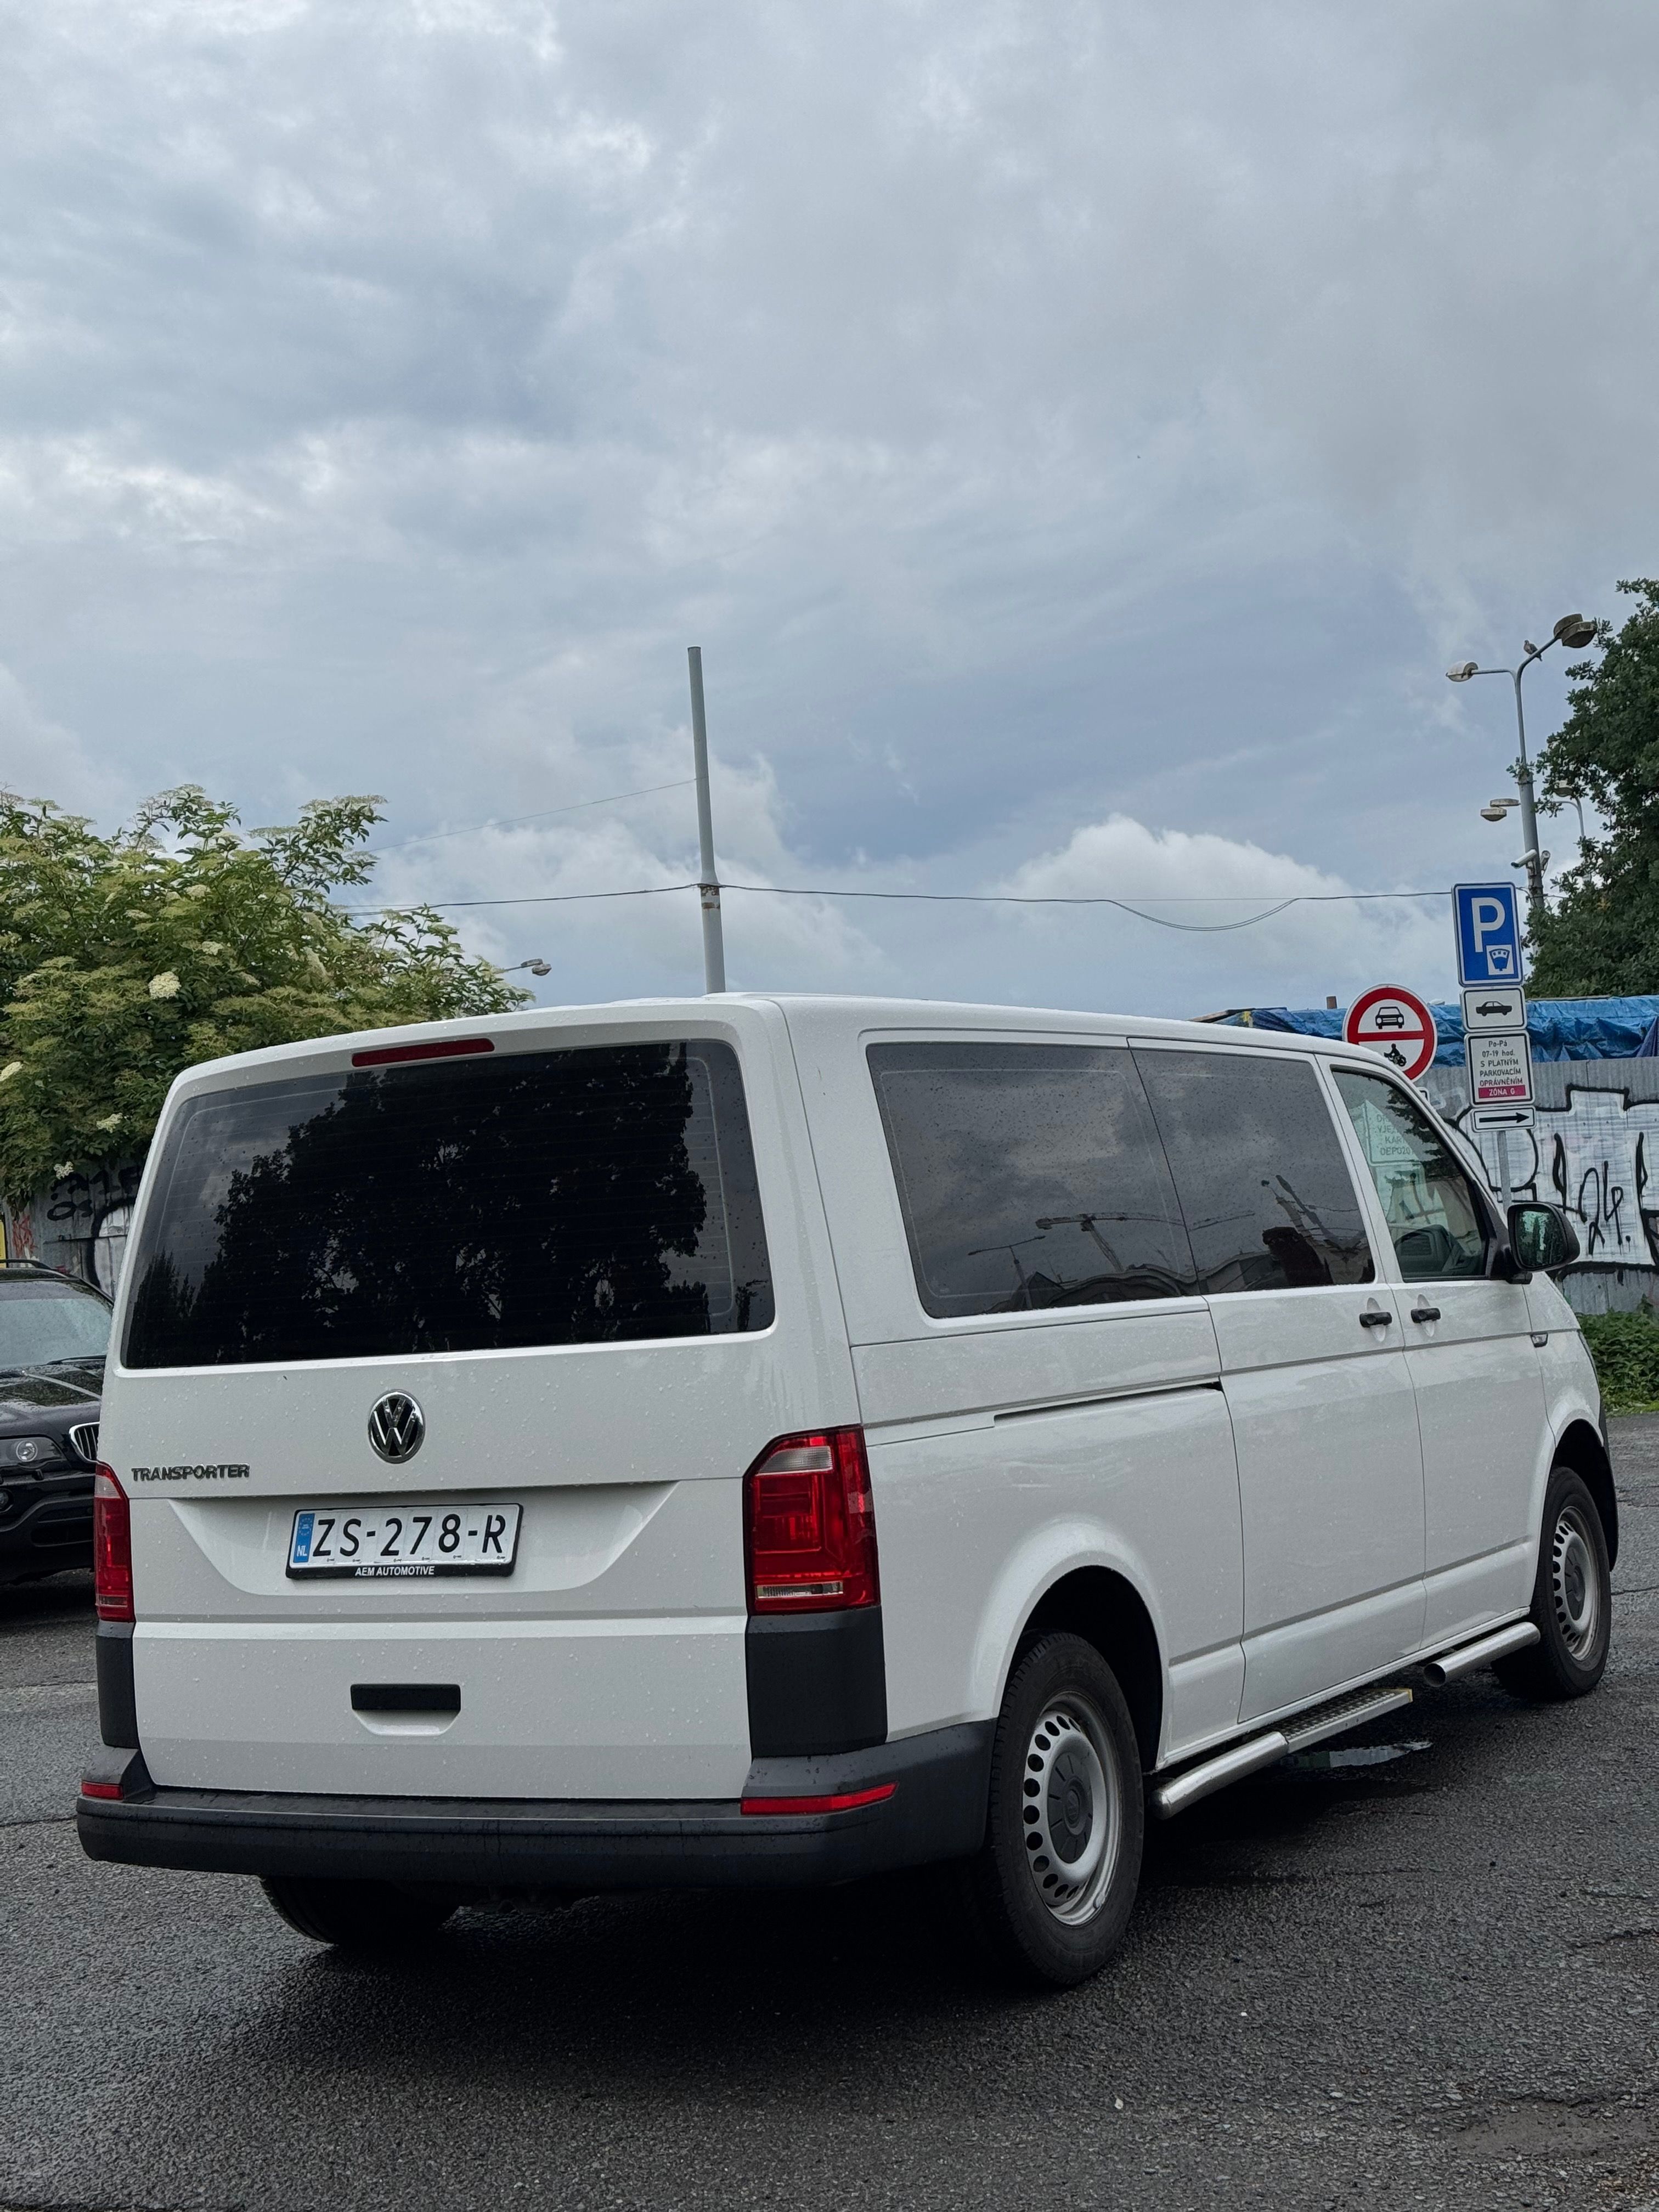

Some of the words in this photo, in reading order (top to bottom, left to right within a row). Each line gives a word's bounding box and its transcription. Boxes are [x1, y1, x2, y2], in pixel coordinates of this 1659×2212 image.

[1471, 897, 1505, 952] P
[1488, 1057, 1519, 1067] PLATNÝM
[1480, 1066, 1521, 1077] PARKOVACÍM
[1480, 1076, 1523, 1087] OPRÁVNĚNÍM
[1488, 1088, 1508, 1096] ZÓNA
[370, 1393, 421, 1459] VW
[131, 1463, 250, 1481] TRANSPORTER
[313, 1514, 506, 1557] ZS-278-R
[297, 1544, 308, 1557] NL
[355, 1567, 375, 1576] AEM
[376, 1566, 435, 1576] AUTOMOTIVE
